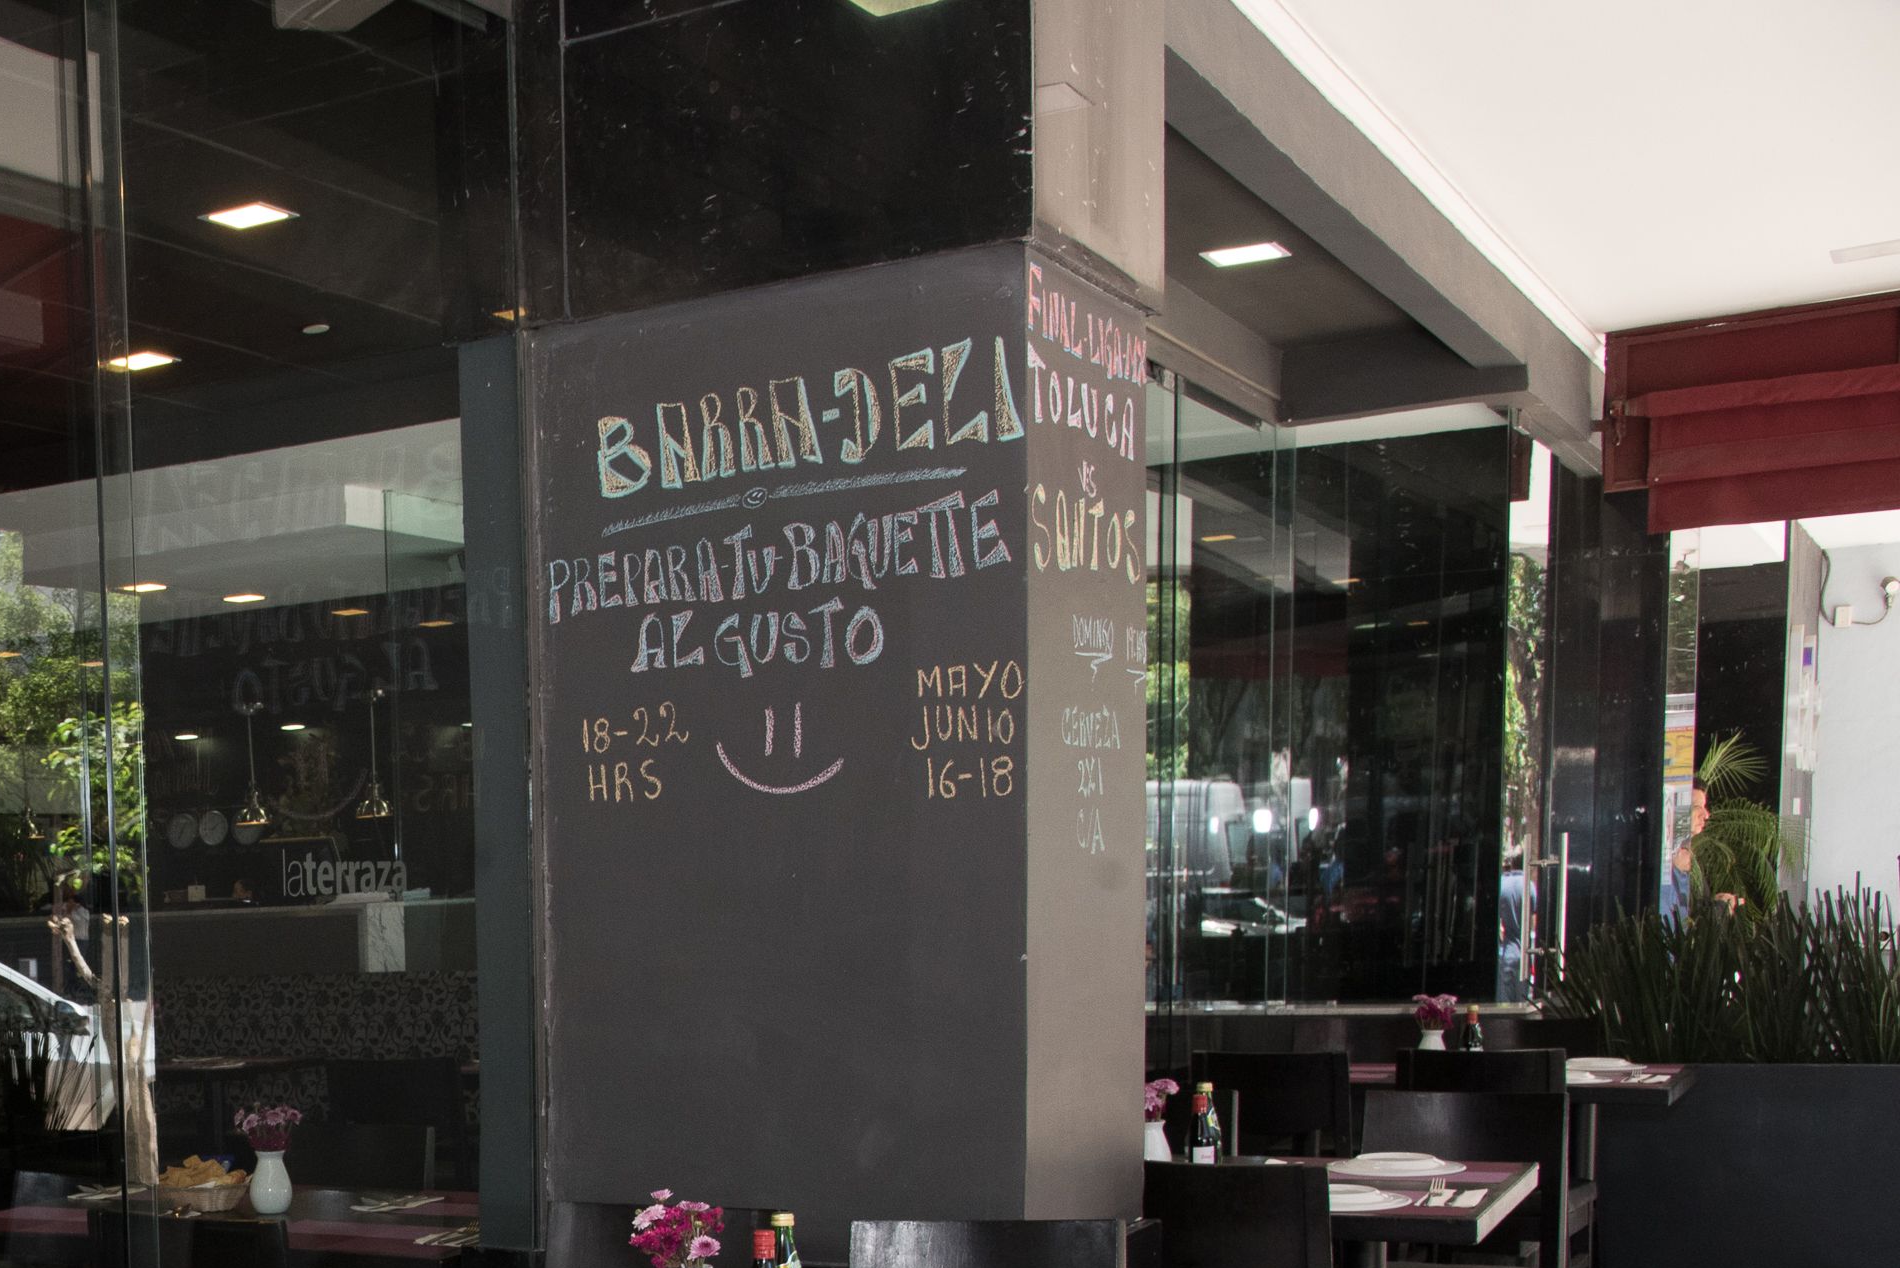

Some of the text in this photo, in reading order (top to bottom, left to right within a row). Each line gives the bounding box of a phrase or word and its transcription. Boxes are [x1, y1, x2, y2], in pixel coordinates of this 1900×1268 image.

[1027, 340, 1135, 461] TOLUCA
[1031, 483, 1141, 585] SANTOS
[631, 596, 884, 678] AL GUSTO
[916, 659, 1025, 700] MAYO
[582, 700, 690, 754] 18-22
[910, 704, 1015, 751] JUNIO
[1061, 704, 1121, 750] CERVEZA
[587, 759, 663, 803] HRS
[926, 755, 1014, 800] 16-18
